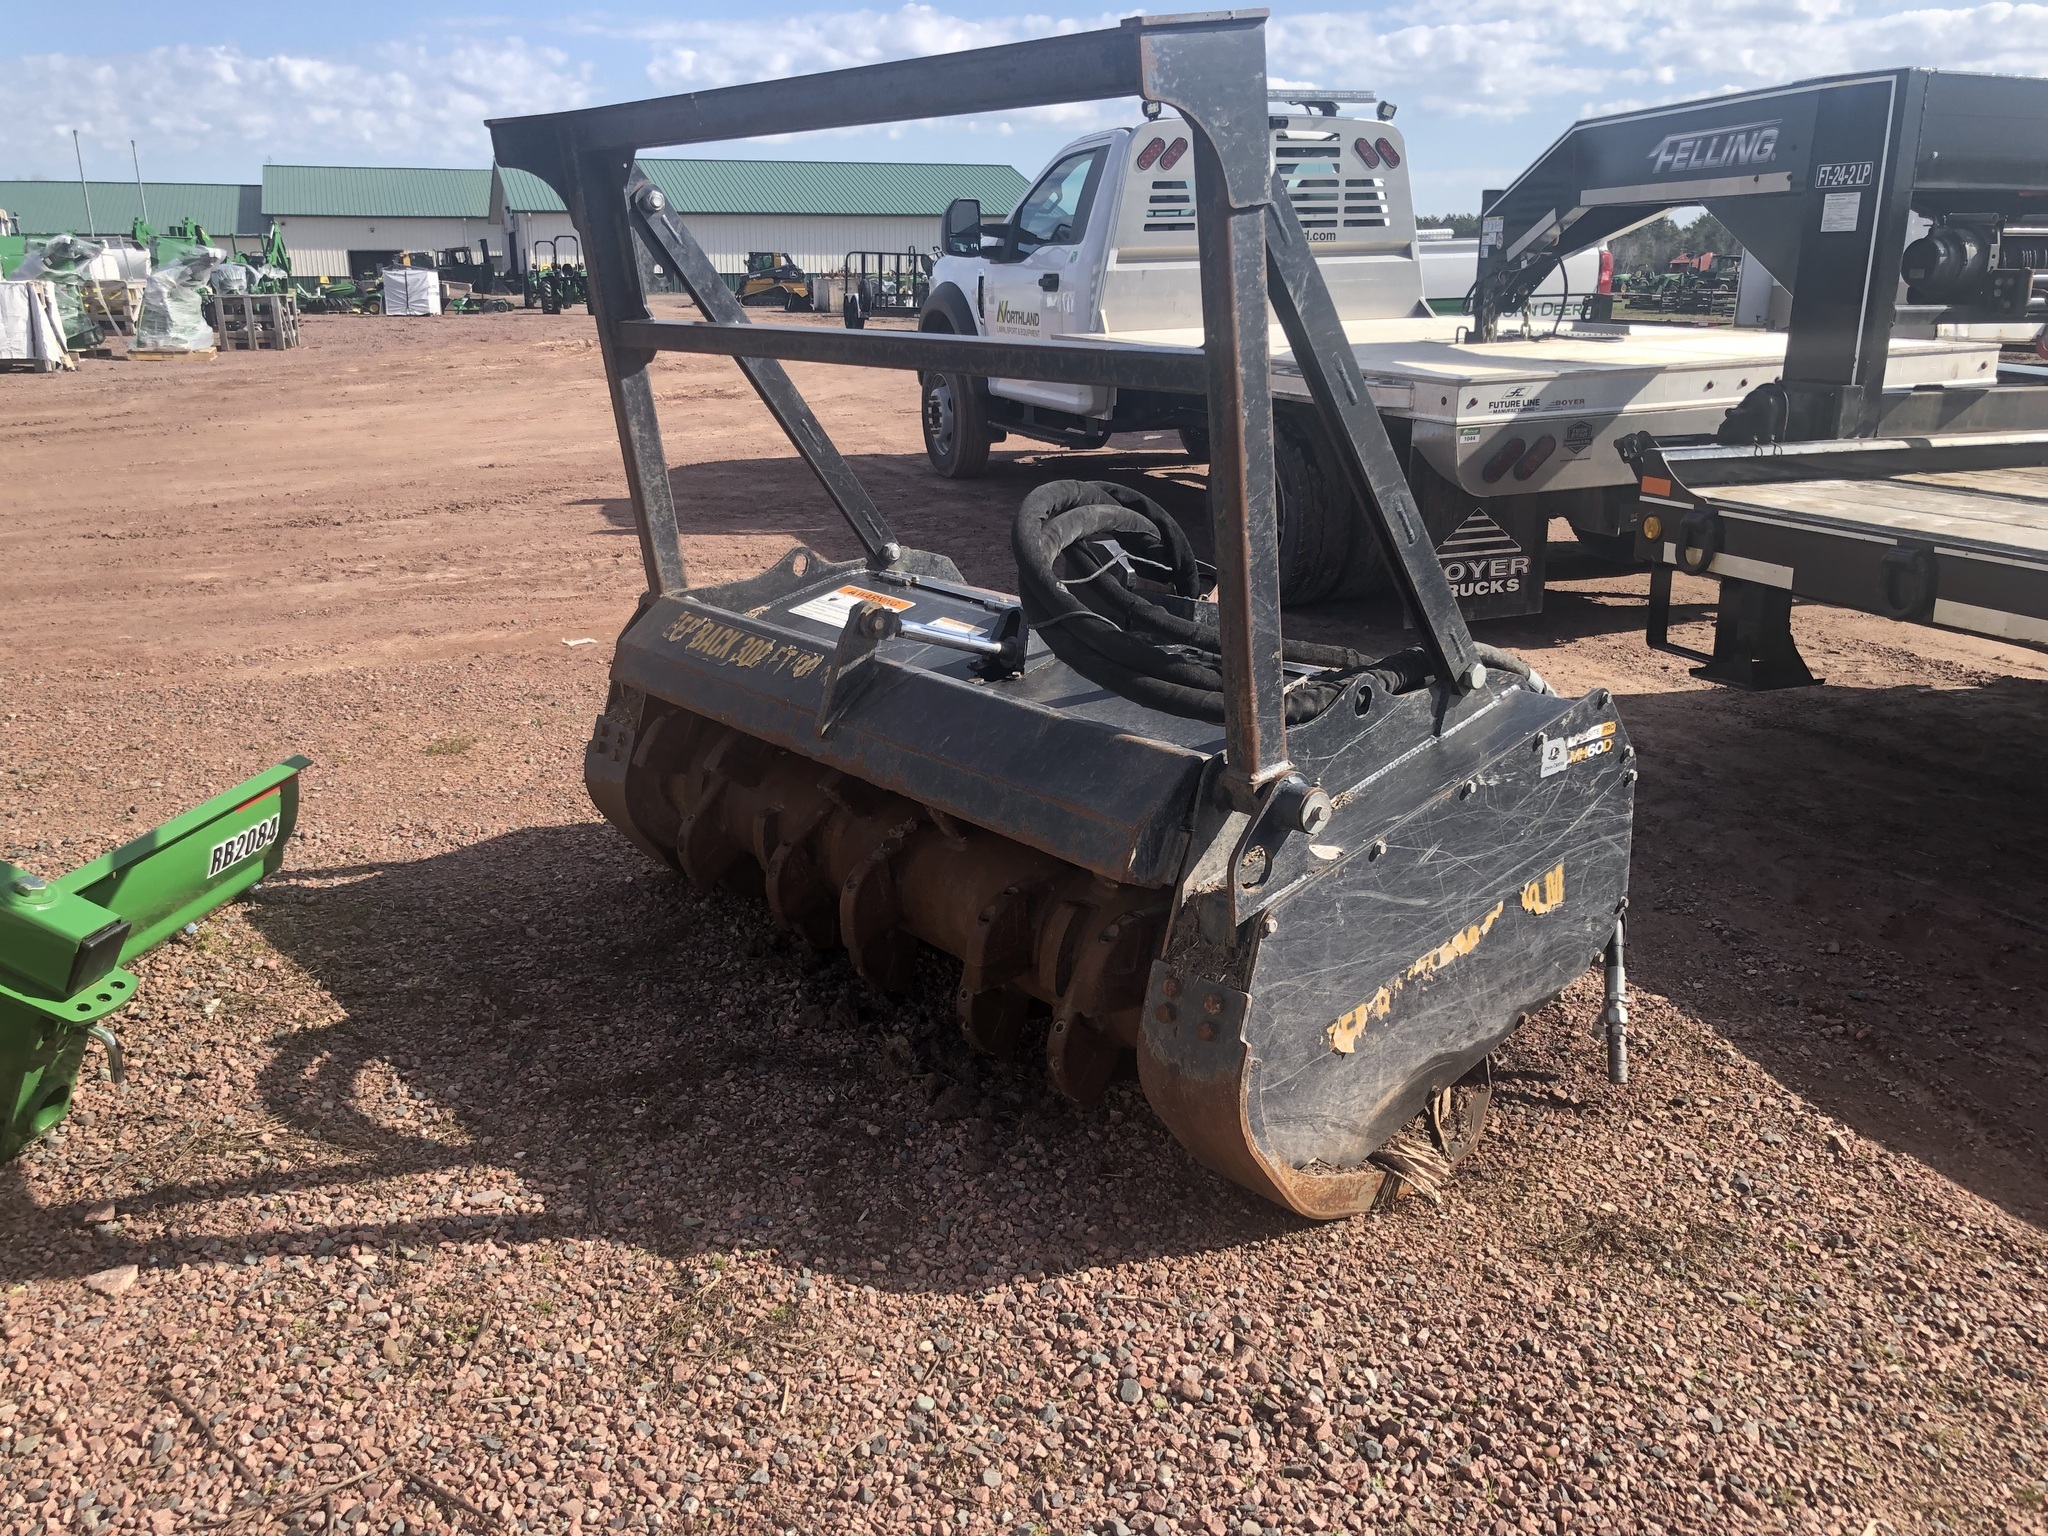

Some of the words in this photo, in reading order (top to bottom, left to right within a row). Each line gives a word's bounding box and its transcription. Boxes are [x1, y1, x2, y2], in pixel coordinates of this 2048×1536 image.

[1646, 119, 1783, 174] FELLING
[1817, 165, 1857, 186] FT-24-2
[1856, 163, 1872, 184] LP
[996, 300, 1040, 327] NORTHLAND
[1488, 400, 1521, 409] FUTURE
[1522, 398, 1541, 407] LINE
[1443, 556, 1532, 583] OYER
[1449, 578, 1520, 598] RUCKS
[687, 620, 745, 660] BACK
[207, 813, 280, 879] RB2084
